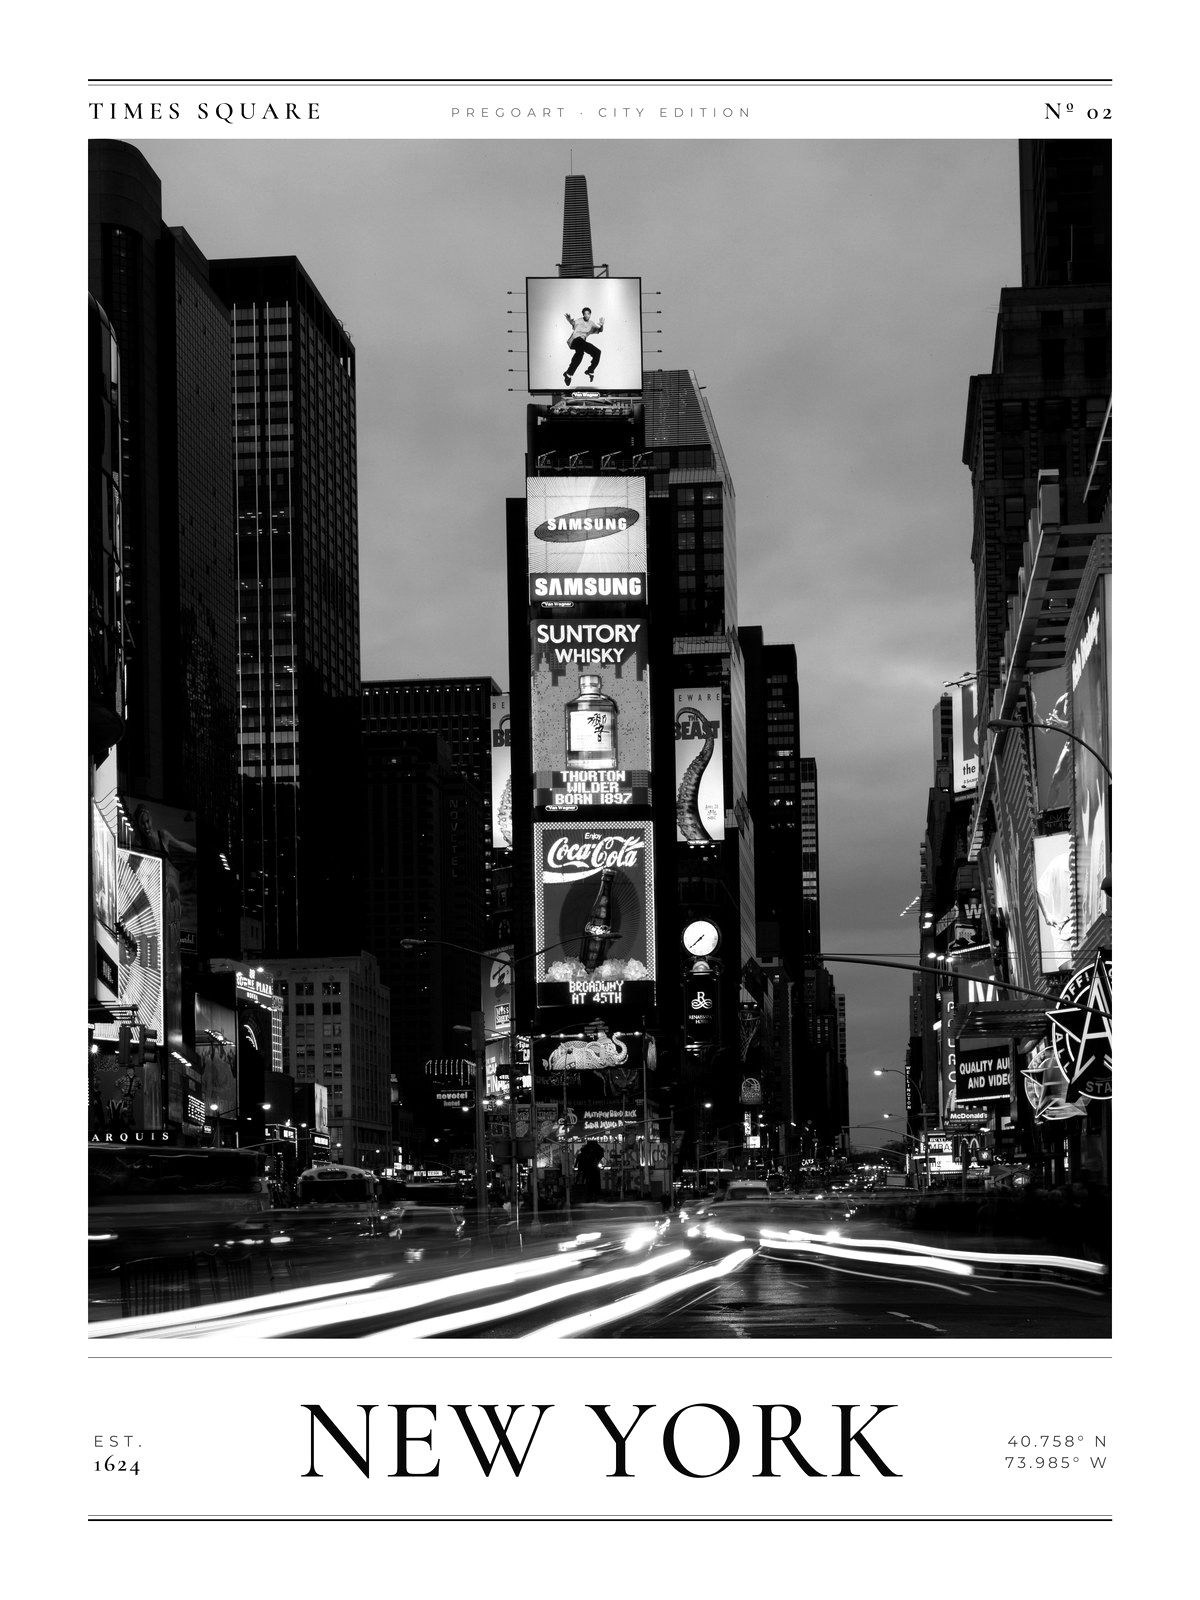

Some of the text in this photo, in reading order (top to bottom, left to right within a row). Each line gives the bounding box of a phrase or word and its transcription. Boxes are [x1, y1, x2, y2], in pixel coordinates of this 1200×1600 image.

[547, 517, 627, 531] SAMSUNG
[534, 577, 642, 597] SAMSUNG
[537, 624, 641, 644] SUNTORY
[554, 648, 625, 664] WHISKY
[962, 763, 976, 776] the
[560, 770, 626, 783] THORTON
[566, 781, 619, 793] WILDER
[555, 792, 633, 805] BORN 1897
[584, 832, 603, 841] Enjoy
[547, 836, 645, 868] Coca-Cola
[256, 980, 274, 996] PLAZA
[569, 980, 624, 993] BROADWAY
[572, 991, 622, 1005] AT 45TH
[959, 1058, 994, 1076] QUALITY
[967, 1076, 986, 1089] AND
[436, 1091, 468, 1100] novotel
